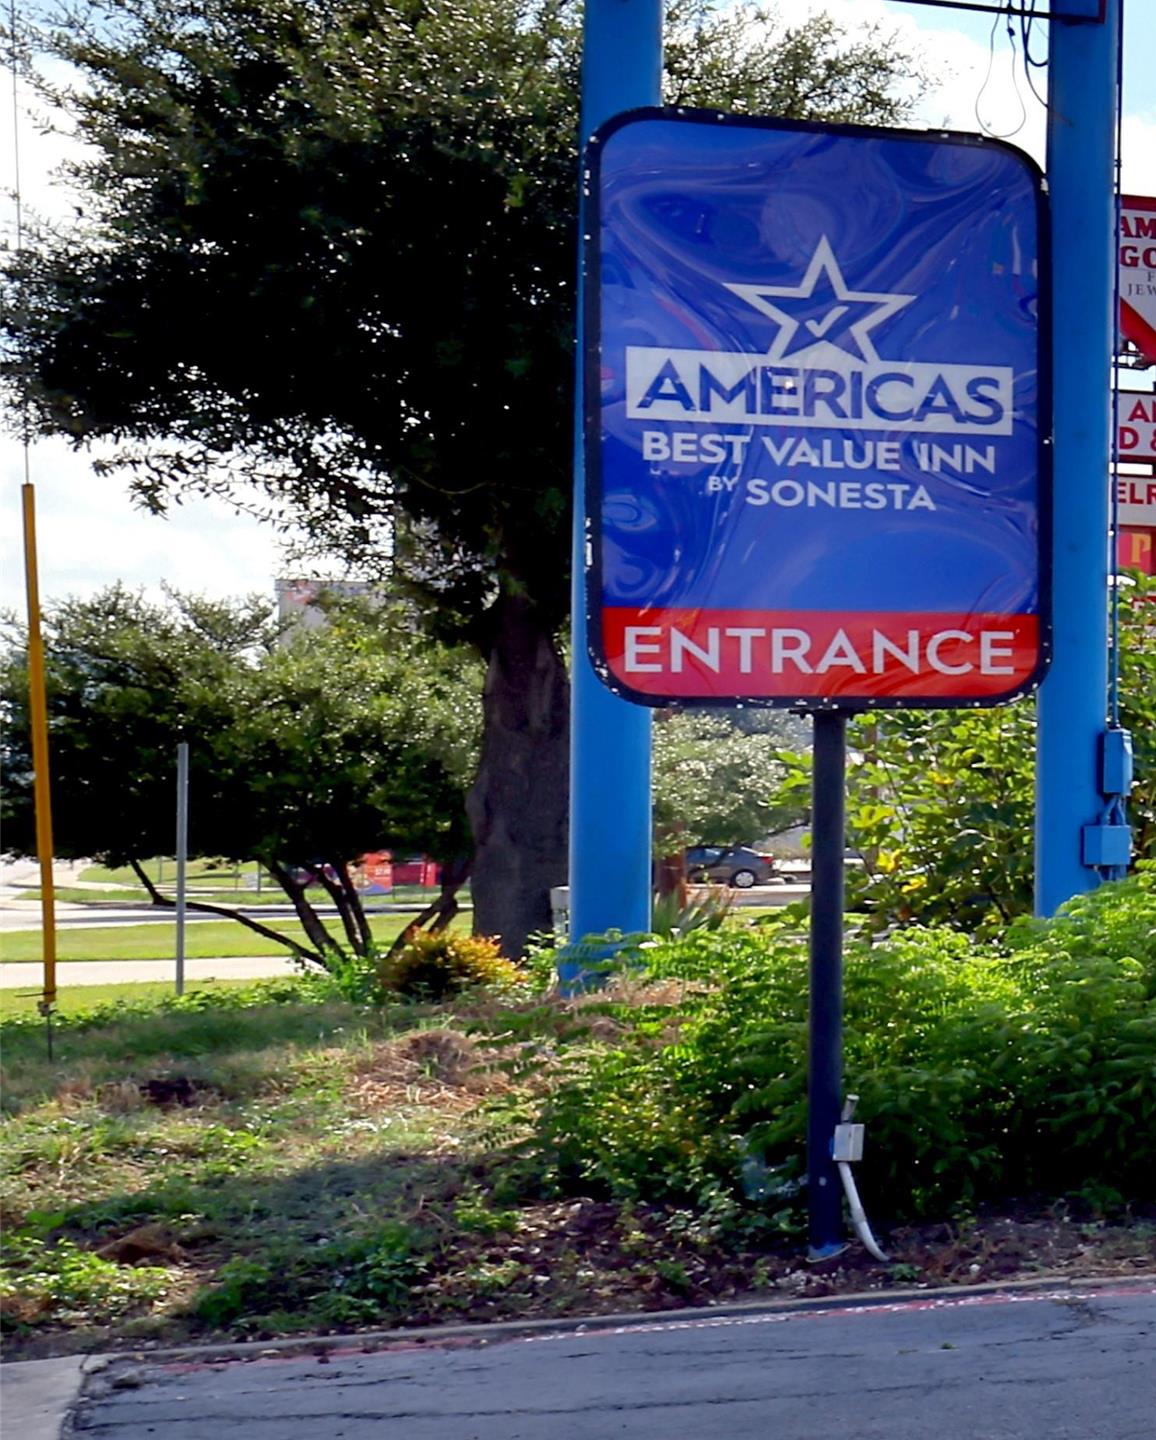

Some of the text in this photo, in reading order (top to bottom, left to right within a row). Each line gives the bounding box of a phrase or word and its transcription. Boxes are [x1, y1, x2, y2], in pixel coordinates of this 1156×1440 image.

[636, 358, 1004, 425] AMERICAS
[642, 431, 995, 474] BEST VALUE INN
[707, 476, 937, 511] BY SONESTA
[623, 625, 1016, 676] ENTRANCE
